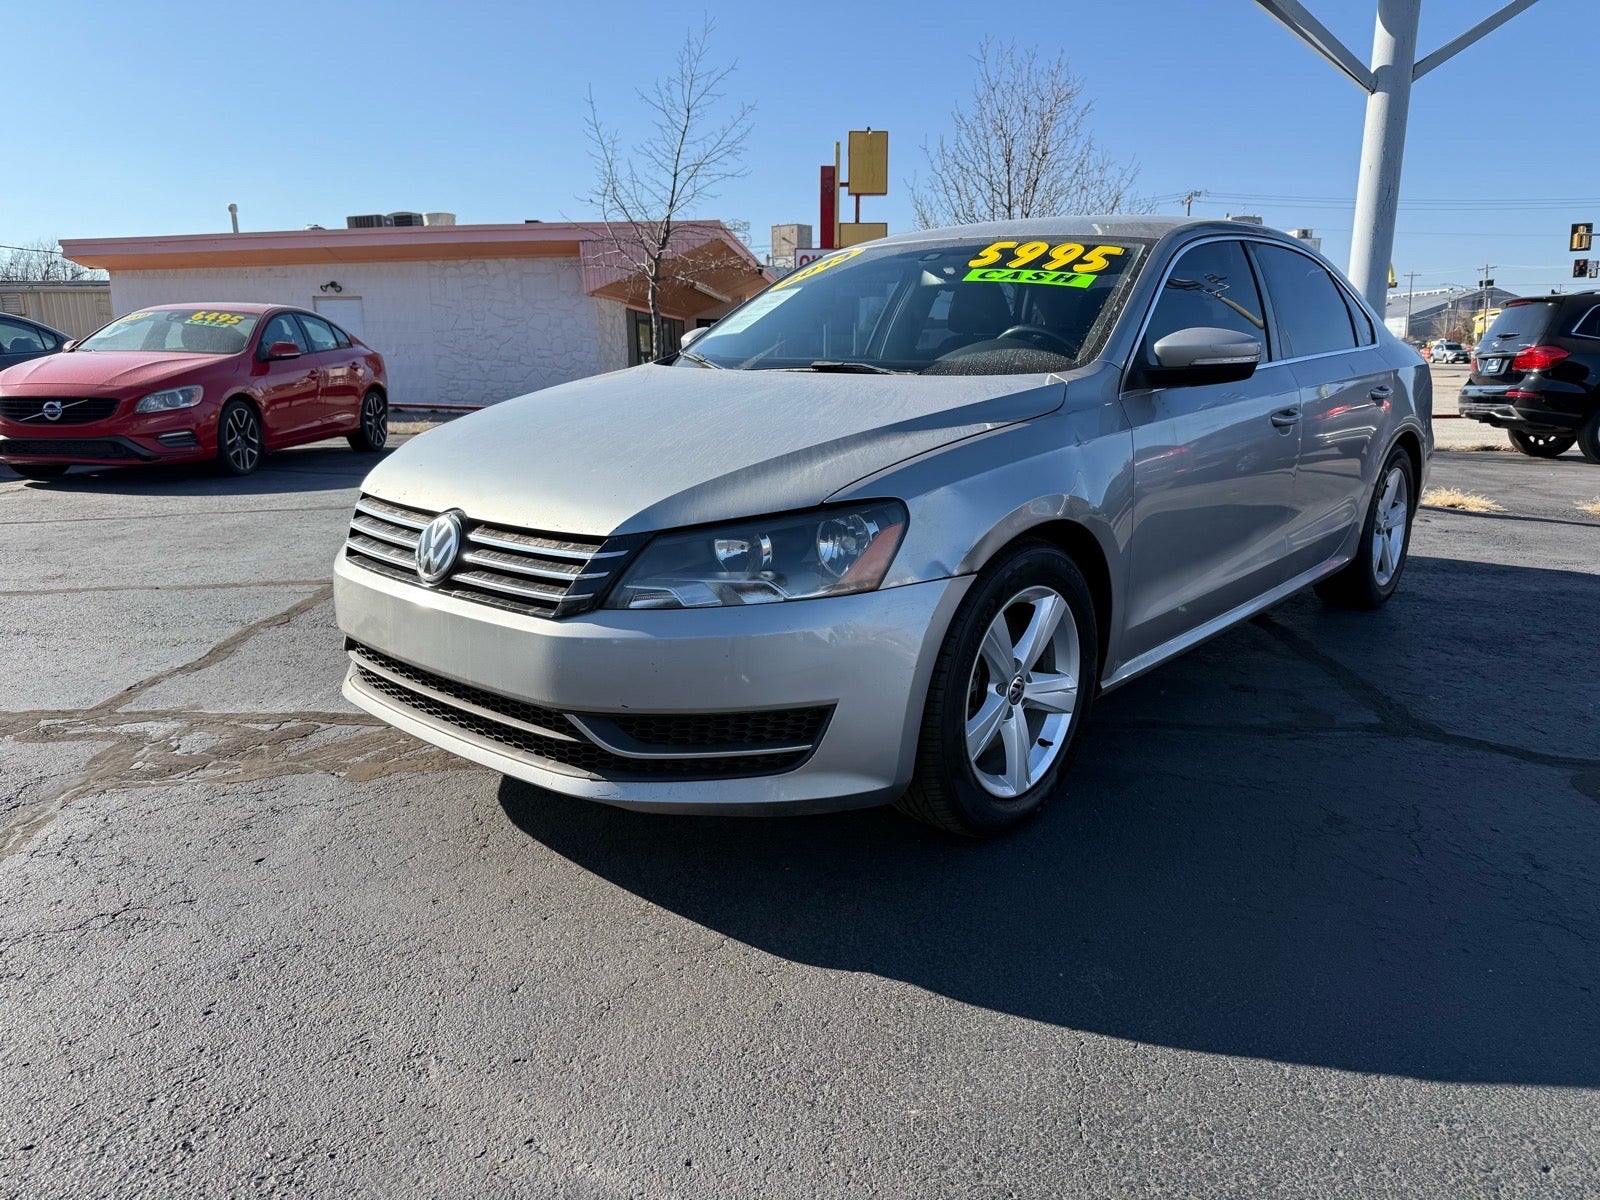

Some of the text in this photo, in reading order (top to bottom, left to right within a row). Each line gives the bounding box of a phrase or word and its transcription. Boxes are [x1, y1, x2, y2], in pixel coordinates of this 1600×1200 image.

[967, 240, 1125, 273] 5995
[977, 270, 1081, 284] CASH
[191, 311, 245, 325] 6495
